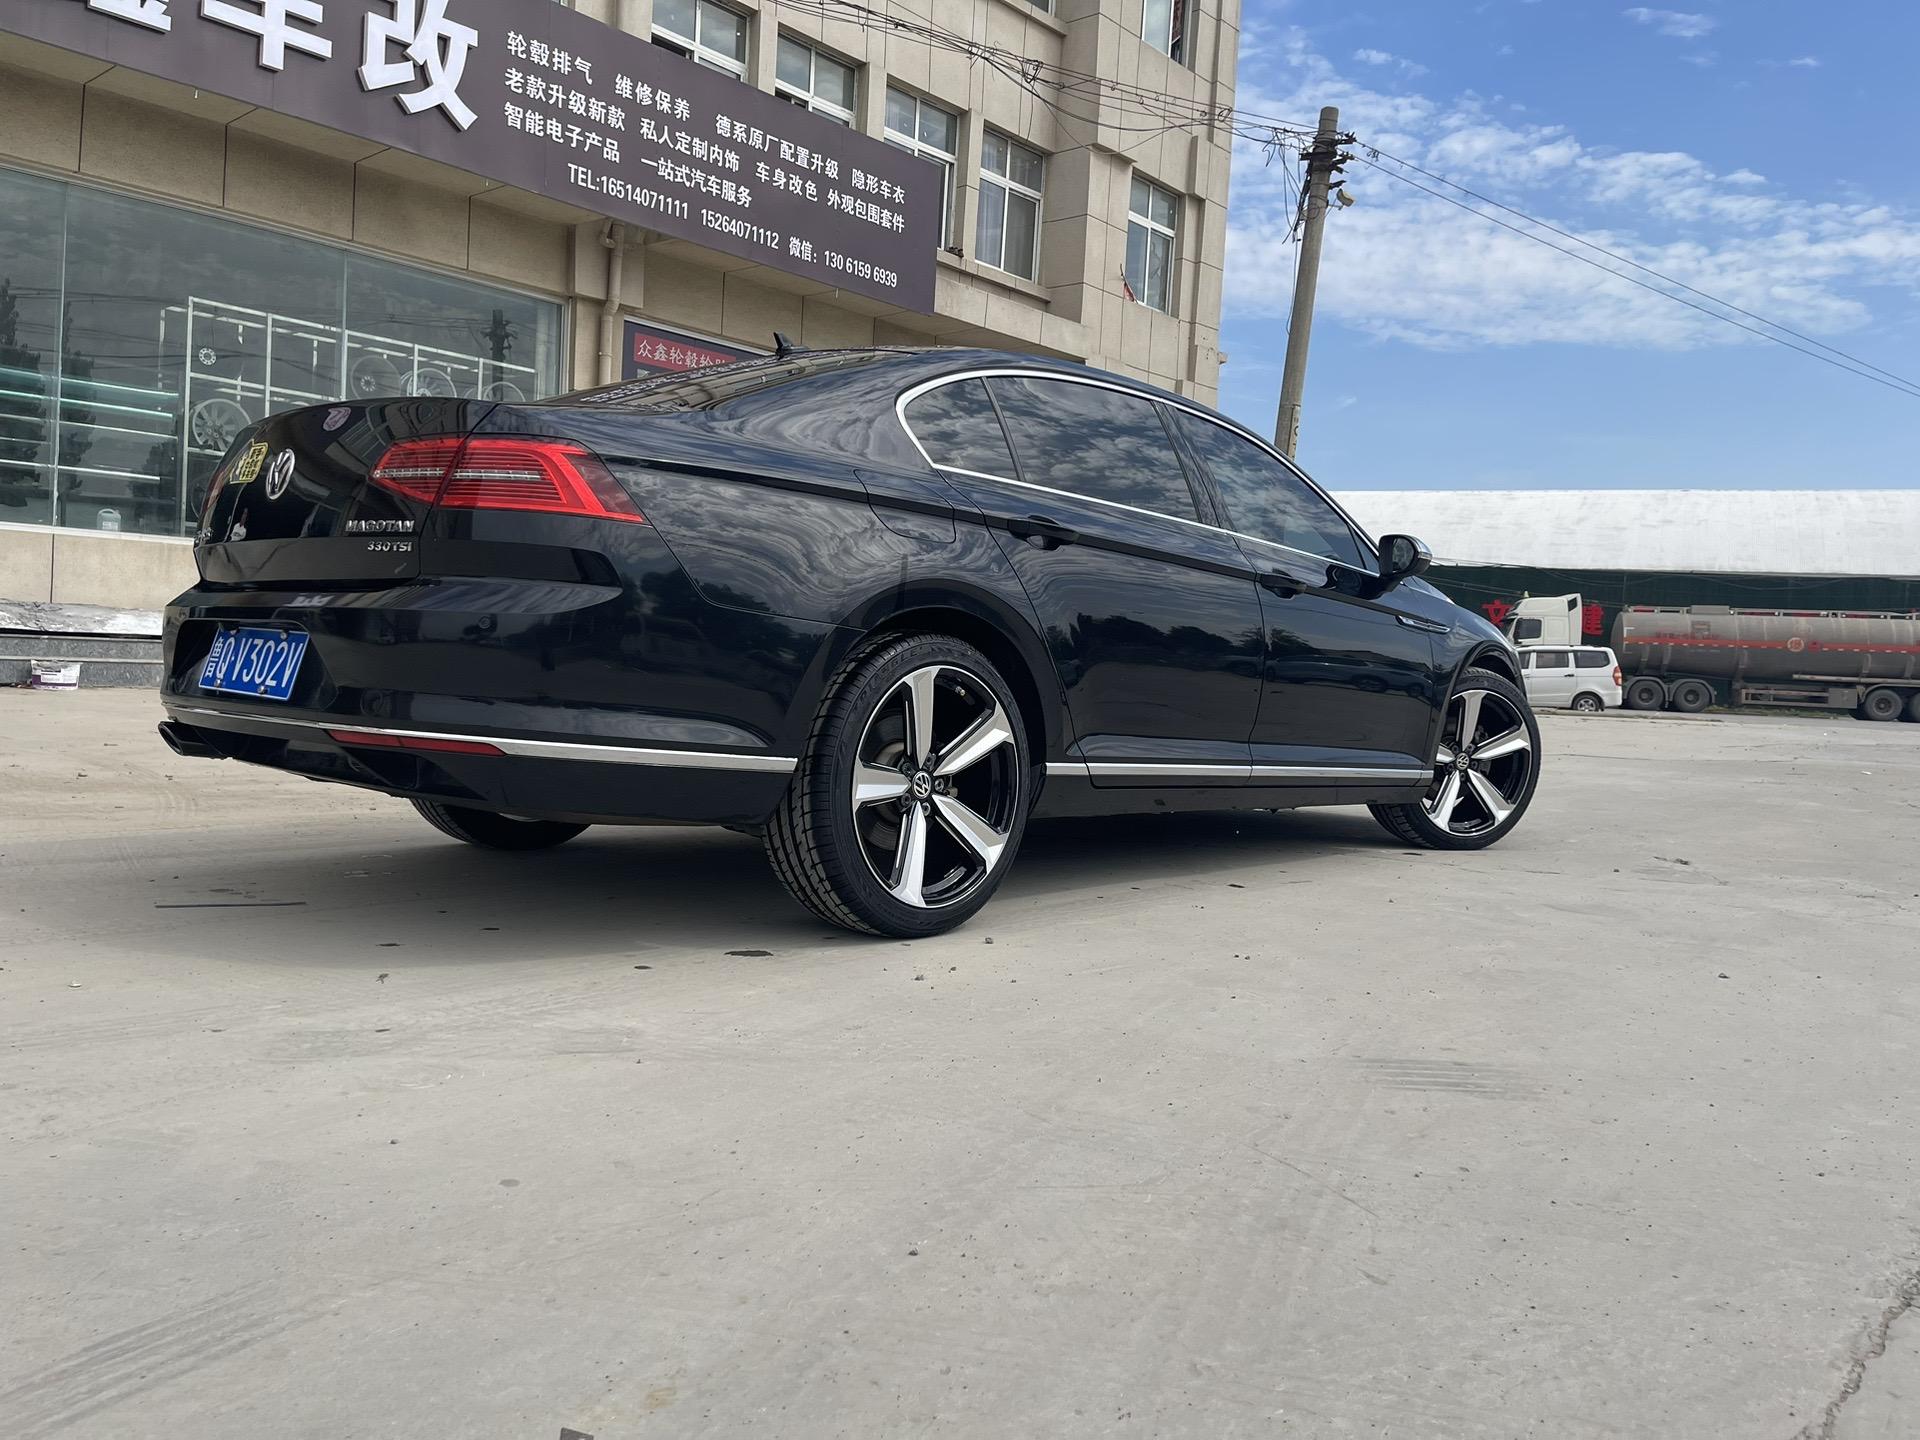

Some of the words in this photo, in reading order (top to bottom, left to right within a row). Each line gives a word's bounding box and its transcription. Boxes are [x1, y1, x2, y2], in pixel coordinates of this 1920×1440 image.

[503, 101, 620, 163] 智能电子产品
[640, 157, 753, 208] 一站式汽车服务
[504, 67, 625, 131] 老款升级新款
[639, 117, 740, 172] 私人定制内饰
[755, 161, 818, 202] 车身改色
[827, 188, 905, 233] 外观包围套件
[506, 30, 593, 85] 轮毂排气
[614, 73, 691, 122] 维修保养
[715, 113, 839, 180] 德系原厂配置升级
[851, 168, 905, 204] 隐形车衣
[567, 162, 688, 219] TEL:16514071111
[700, 208, 780, 250] 15264071112
[345, 519, 415, 533] MAGOTAN
